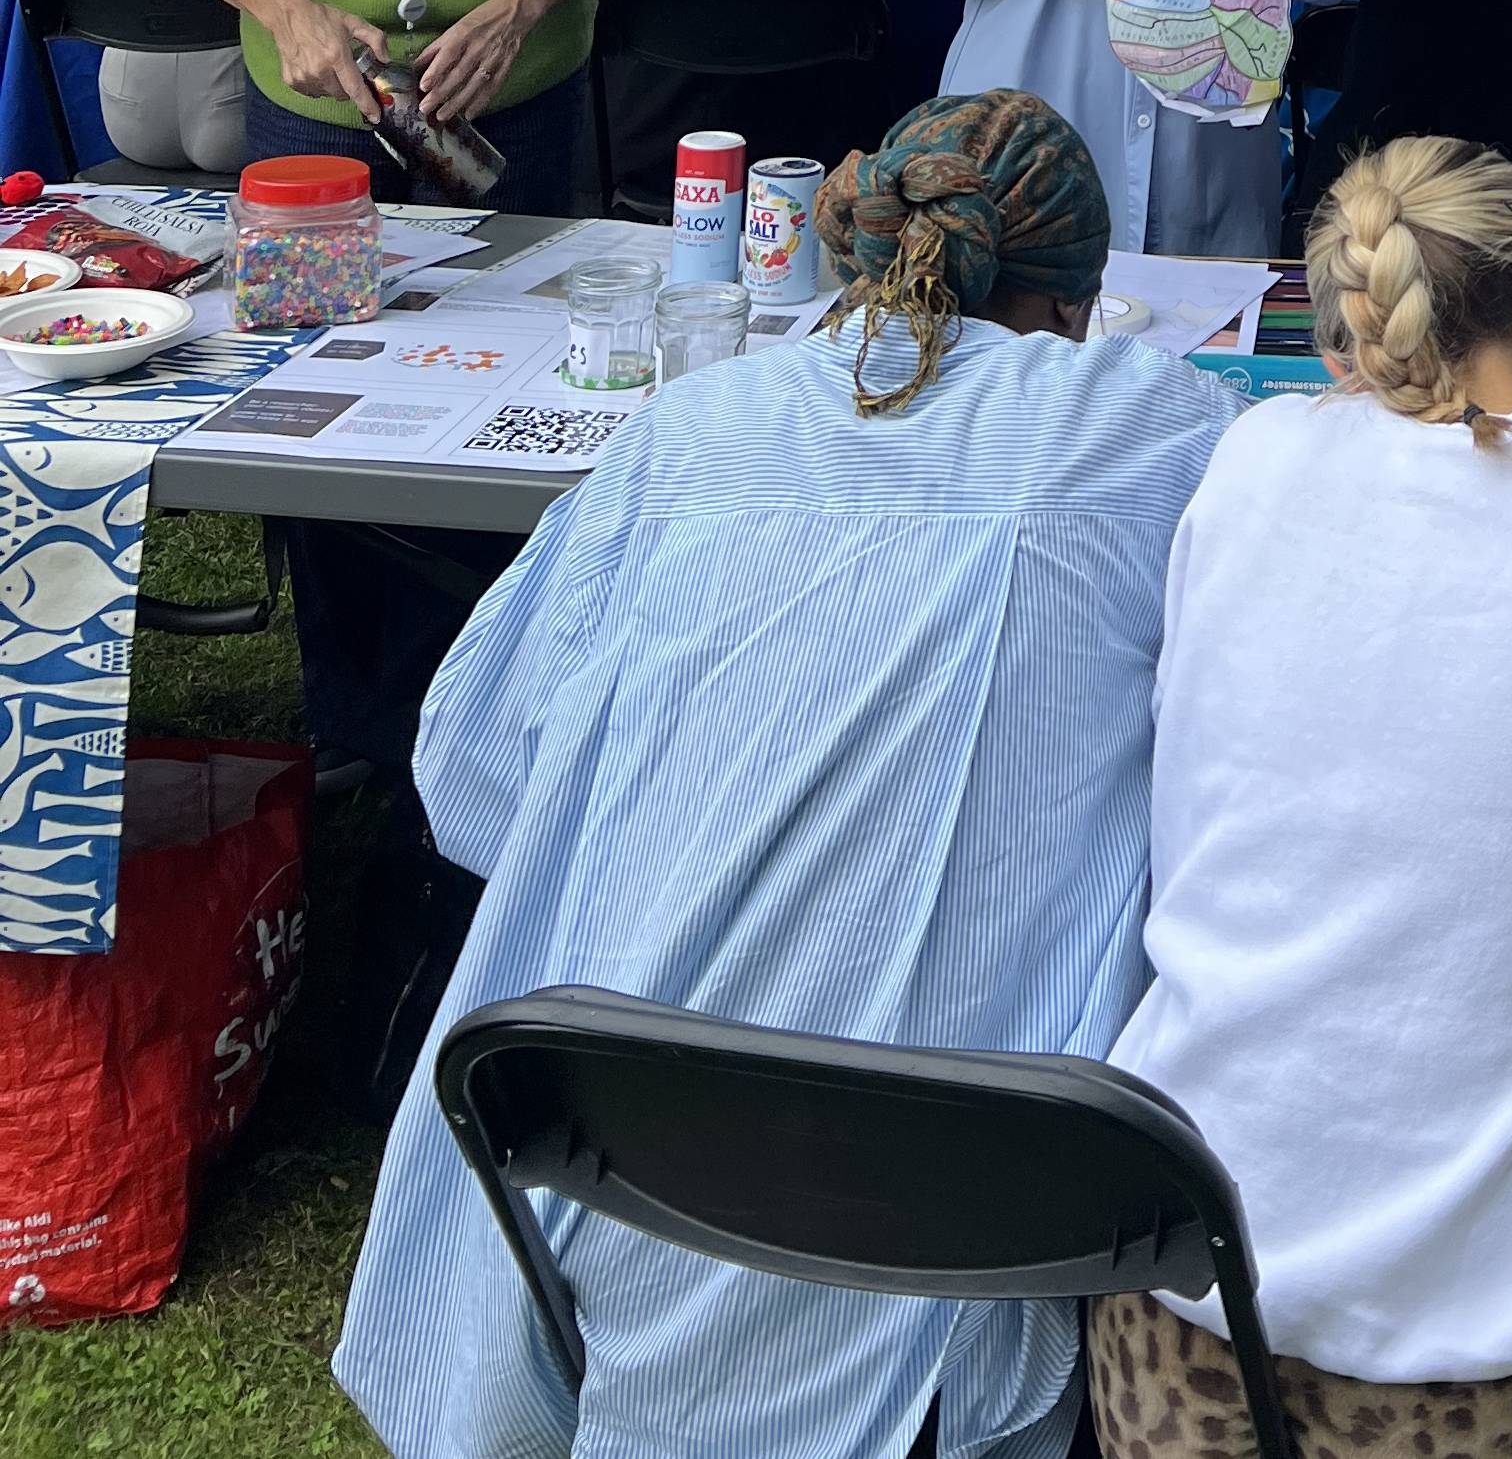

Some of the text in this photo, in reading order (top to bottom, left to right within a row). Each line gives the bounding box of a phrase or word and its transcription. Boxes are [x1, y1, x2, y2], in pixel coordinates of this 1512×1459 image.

[675, 182, 721, 203] SAXA
[753, 209, 775, 223] LO
[749, 220, 779, 240] SALT
[24, 1211, 52, 1229] Aldi
